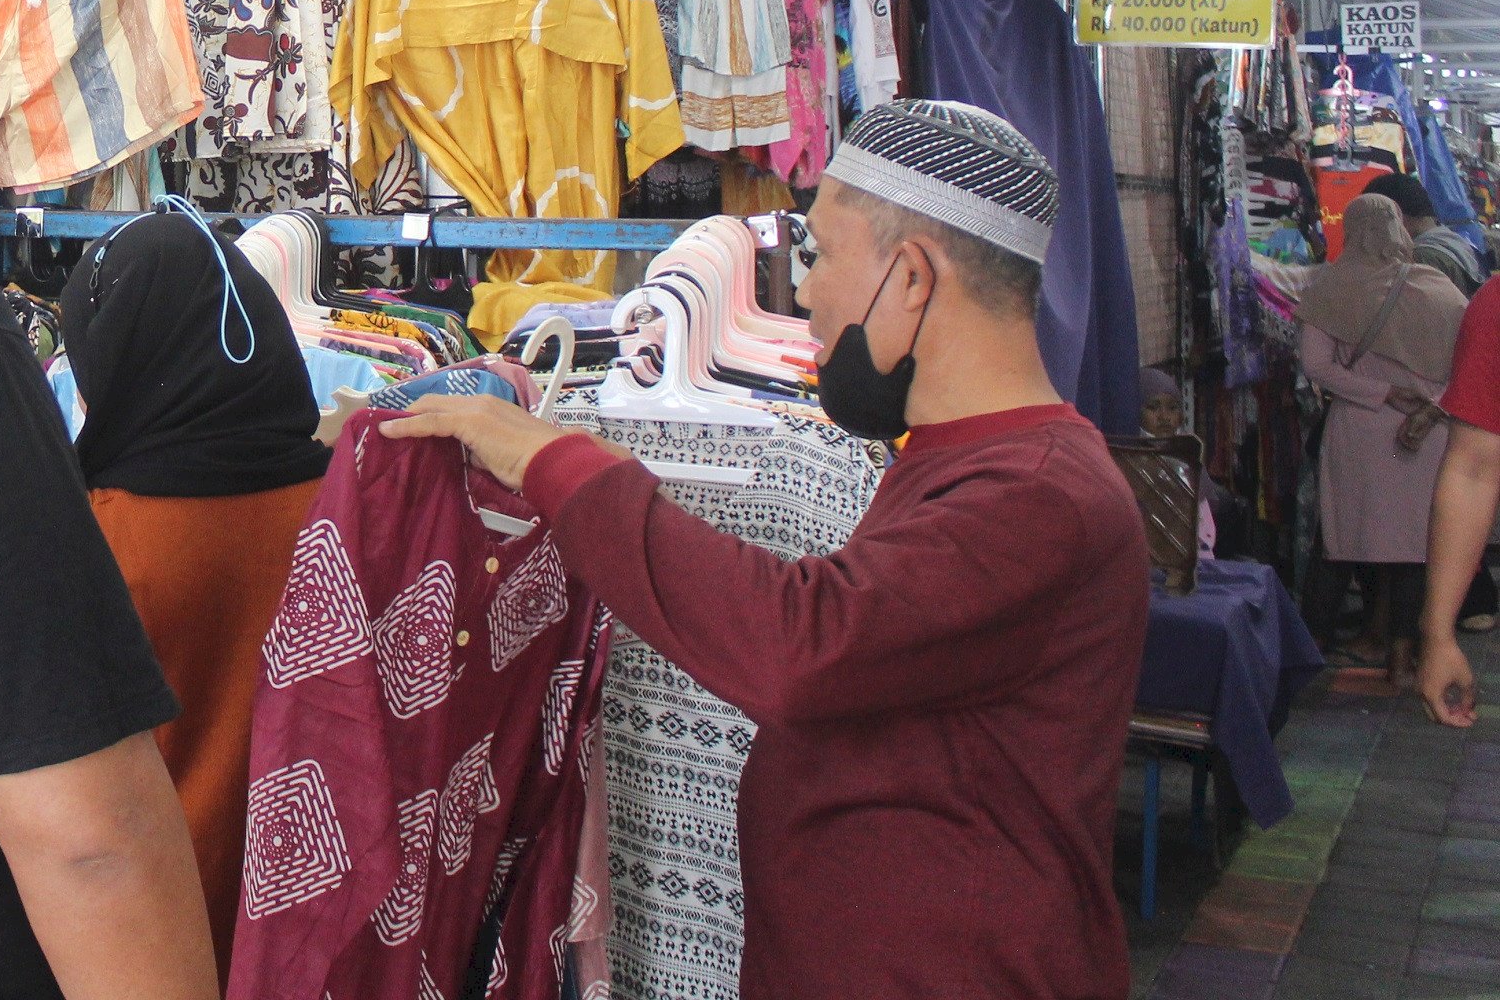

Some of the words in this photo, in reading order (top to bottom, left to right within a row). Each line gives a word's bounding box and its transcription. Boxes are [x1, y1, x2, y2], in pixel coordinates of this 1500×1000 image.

[1346, 5, 1416, 22] KAOS
[1122, 16, 1186, 32] 40.000
[1190, 17, 1259, 37] (Katun)
[1346, 22, 1415, 36] KATUN
